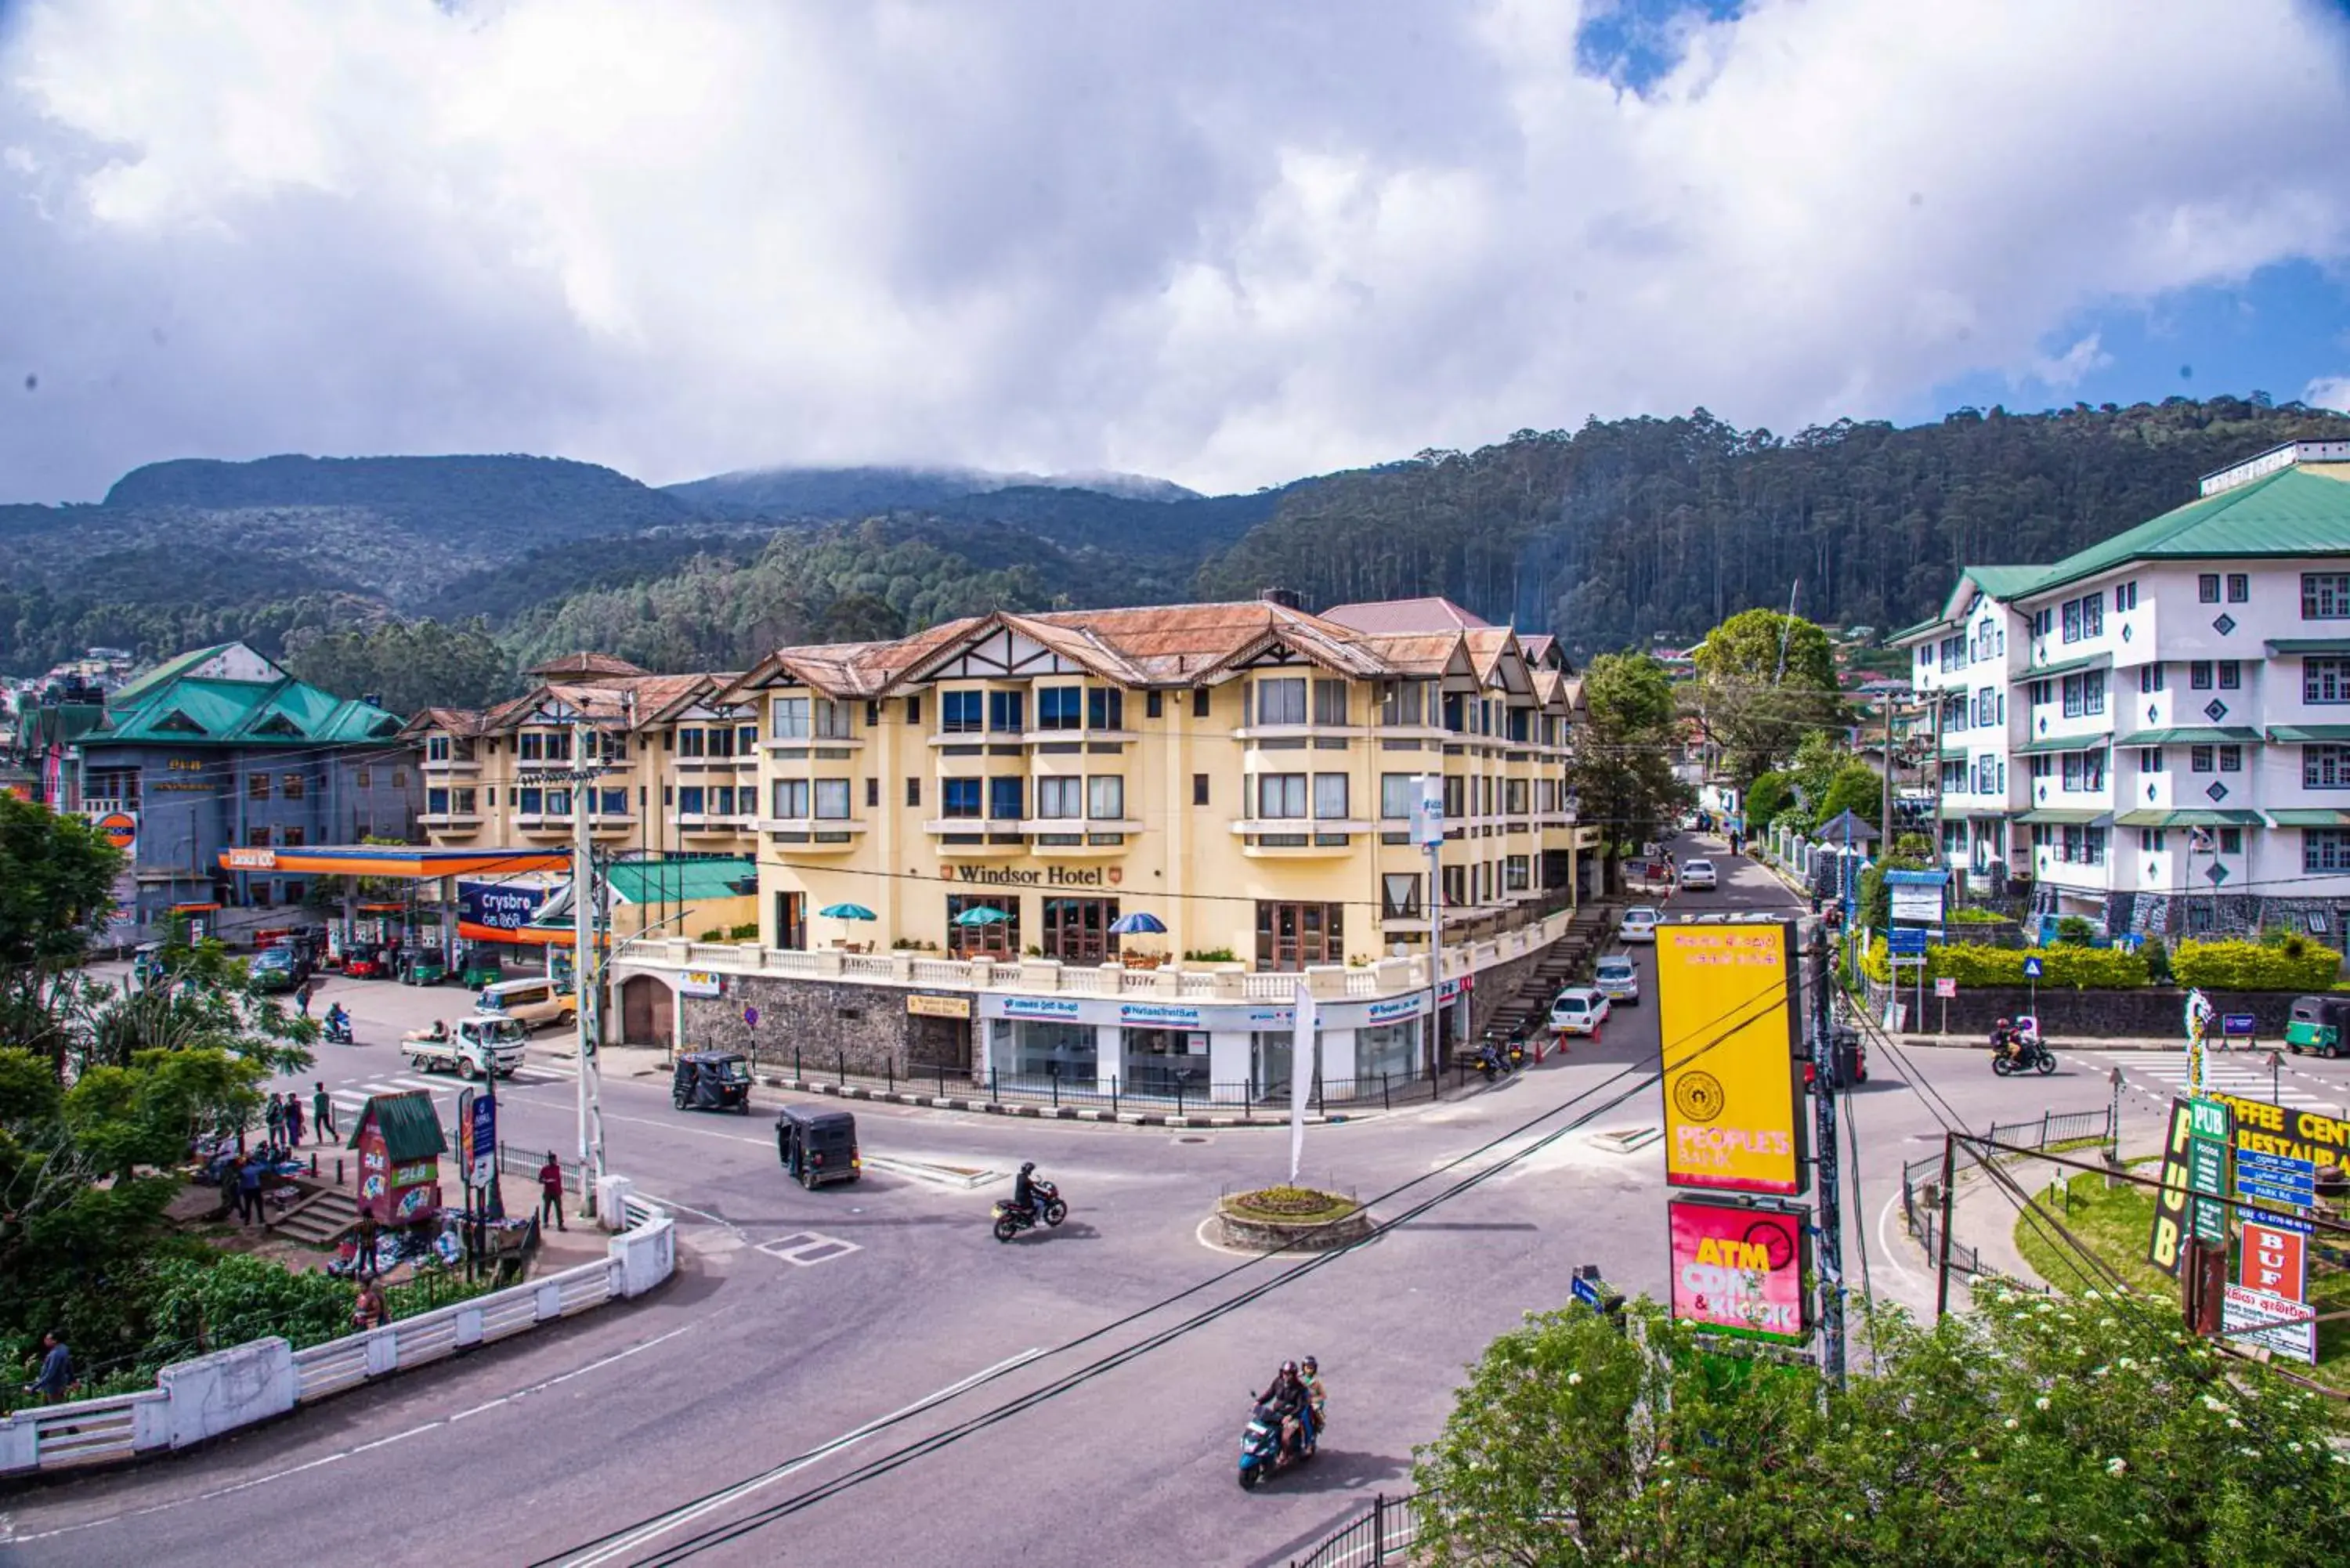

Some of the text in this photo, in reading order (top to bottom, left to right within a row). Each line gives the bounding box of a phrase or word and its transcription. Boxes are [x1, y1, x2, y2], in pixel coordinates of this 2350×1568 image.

[958, 864, 1102, 885] Windsor Hotel
[2194, 1104, 2223, 1135] PUB
[1679, 1147, 1734, 1169] BANK
[2154, 1107, 2191, 1267] PUB
[2255, 1186, 2277, 1197] PARK
[1696, 1237, 1770, 1274] ATM
[1695, 1294, 1708, 1310] &
